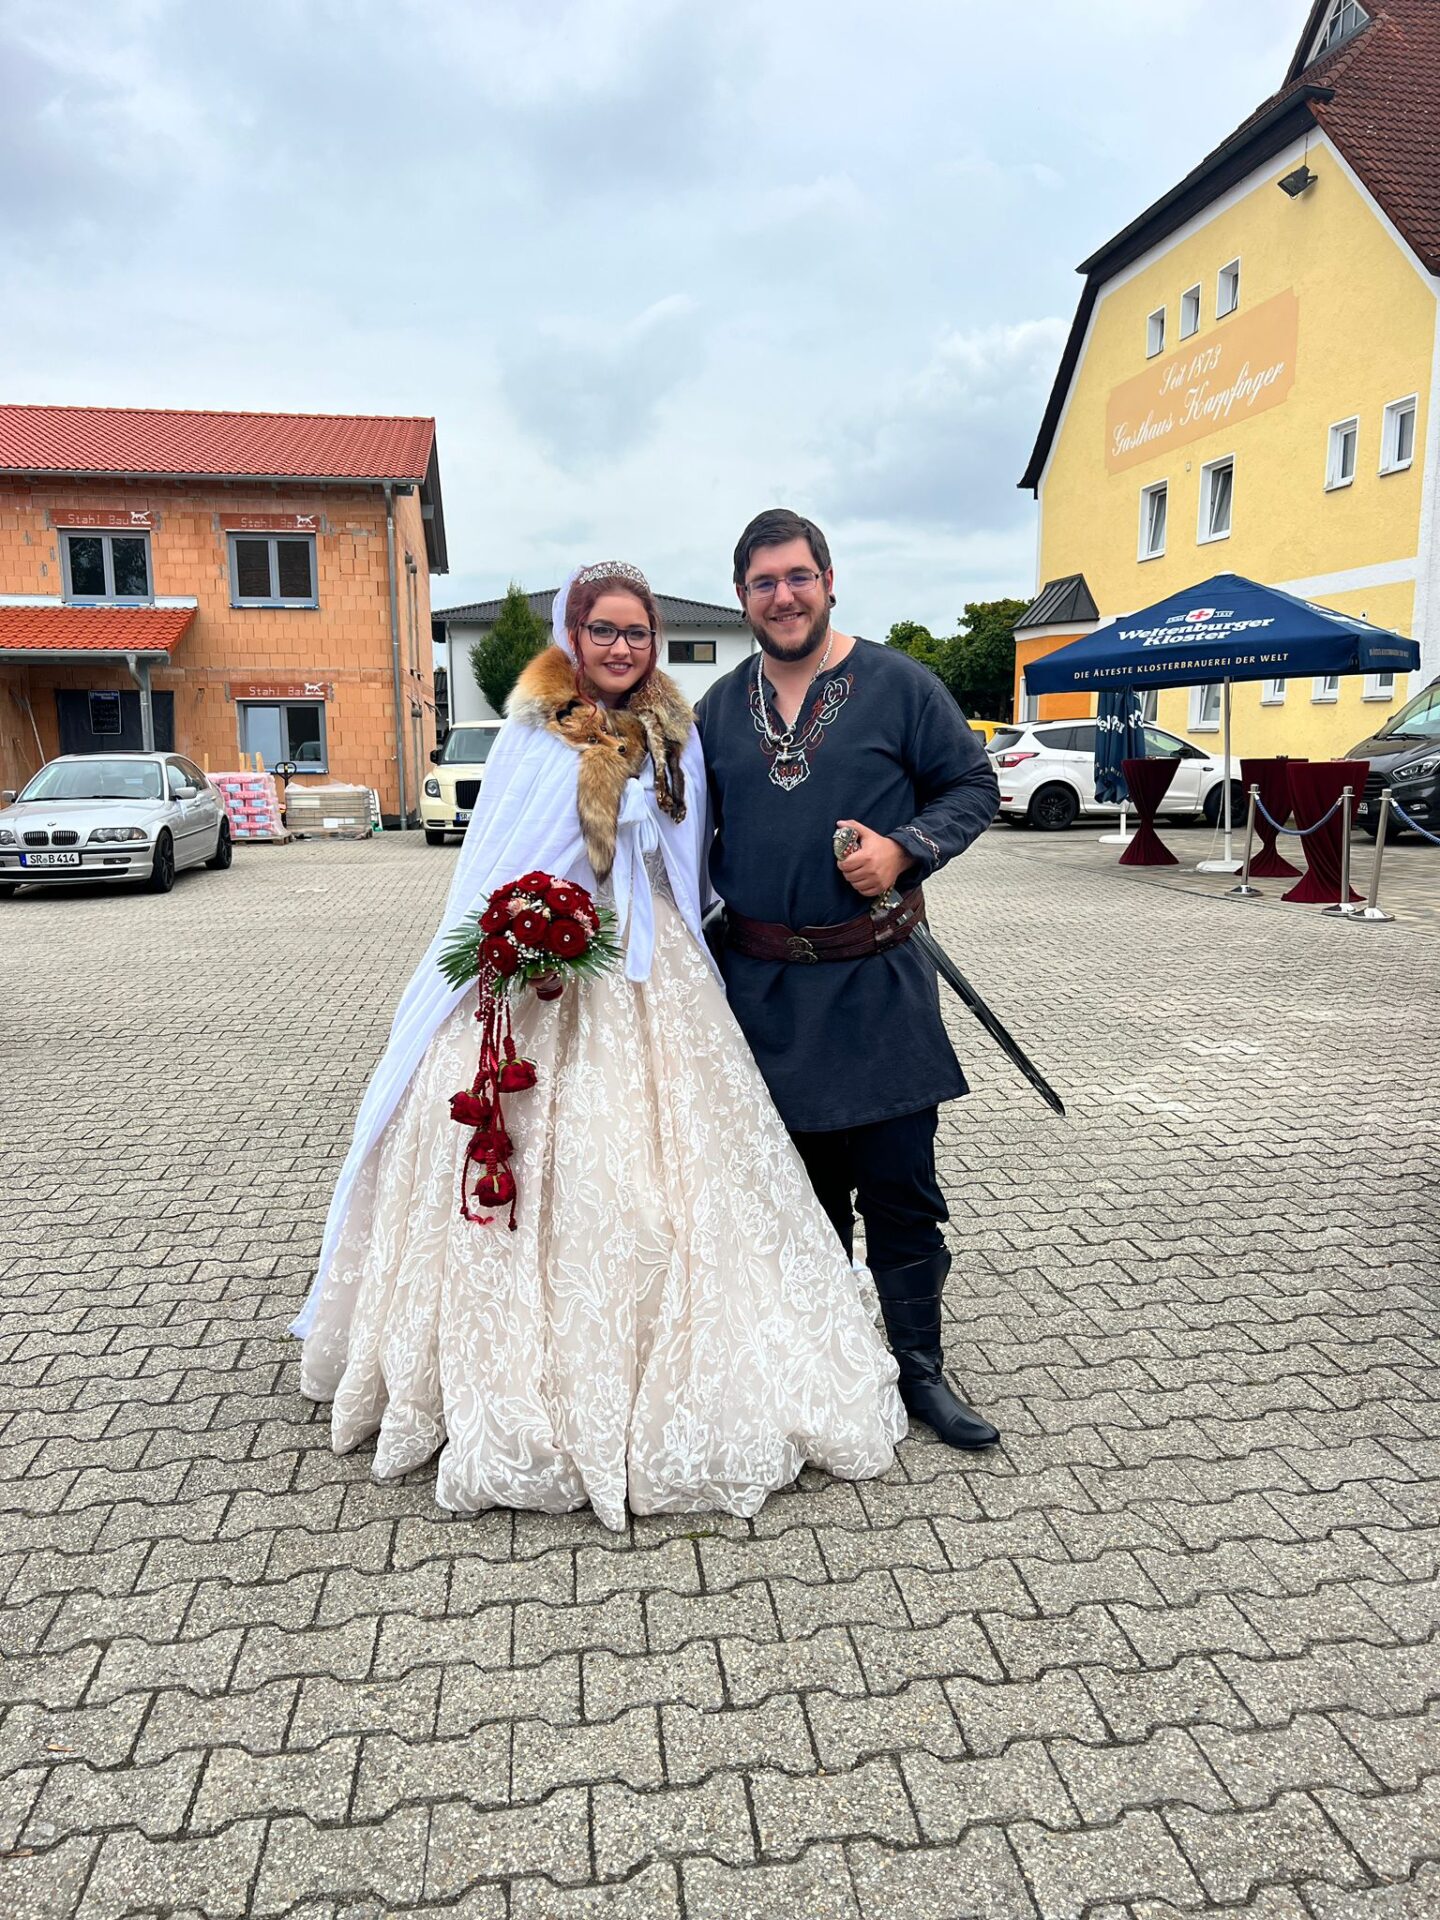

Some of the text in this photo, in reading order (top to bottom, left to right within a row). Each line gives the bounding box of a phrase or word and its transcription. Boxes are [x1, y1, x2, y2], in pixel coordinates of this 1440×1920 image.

[1159, 343, 1222, 396] Seit 1873
[1112, 361, 1285, 457] Gasthaus Karpfinger
[68, 514, 129, 525] Stahl Bau
[241, 517, 273, 528] Stahl
[1118, 617, 1275, 641] Weltenburger
[1142, 630, 1231, 647] Kloster
[1074, 653, 1289, 680] DIE ÄLTESTE KLOSTERBRAUEREI DER WELT
[249, 686, 280, 696] Stahl
